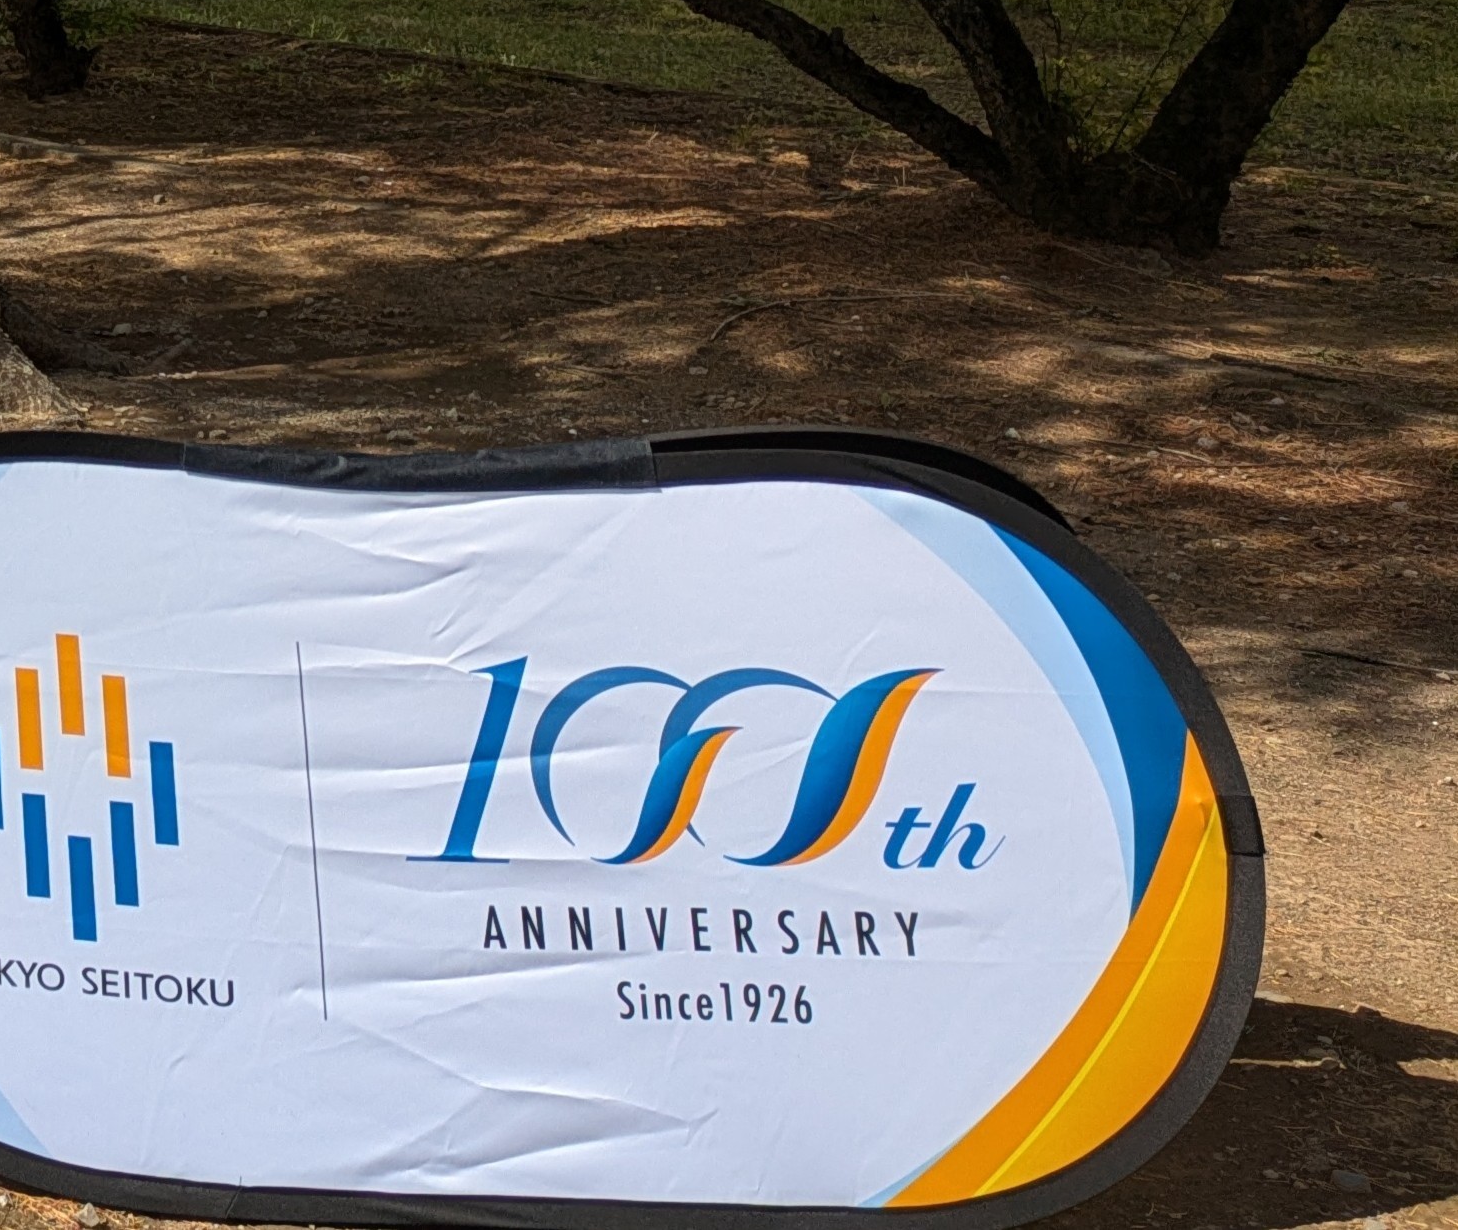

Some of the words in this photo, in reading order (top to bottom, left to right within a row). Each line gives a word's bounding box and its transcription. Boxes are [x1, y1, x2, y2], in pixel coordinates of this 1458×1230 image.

[405, 655, 1005, 871] 100th
[482, 904, 921, 957] ANNIVERSARY
[79, 968, 235, 1007] SEITOKU
[616, 980, 813, 1025] Since1926
